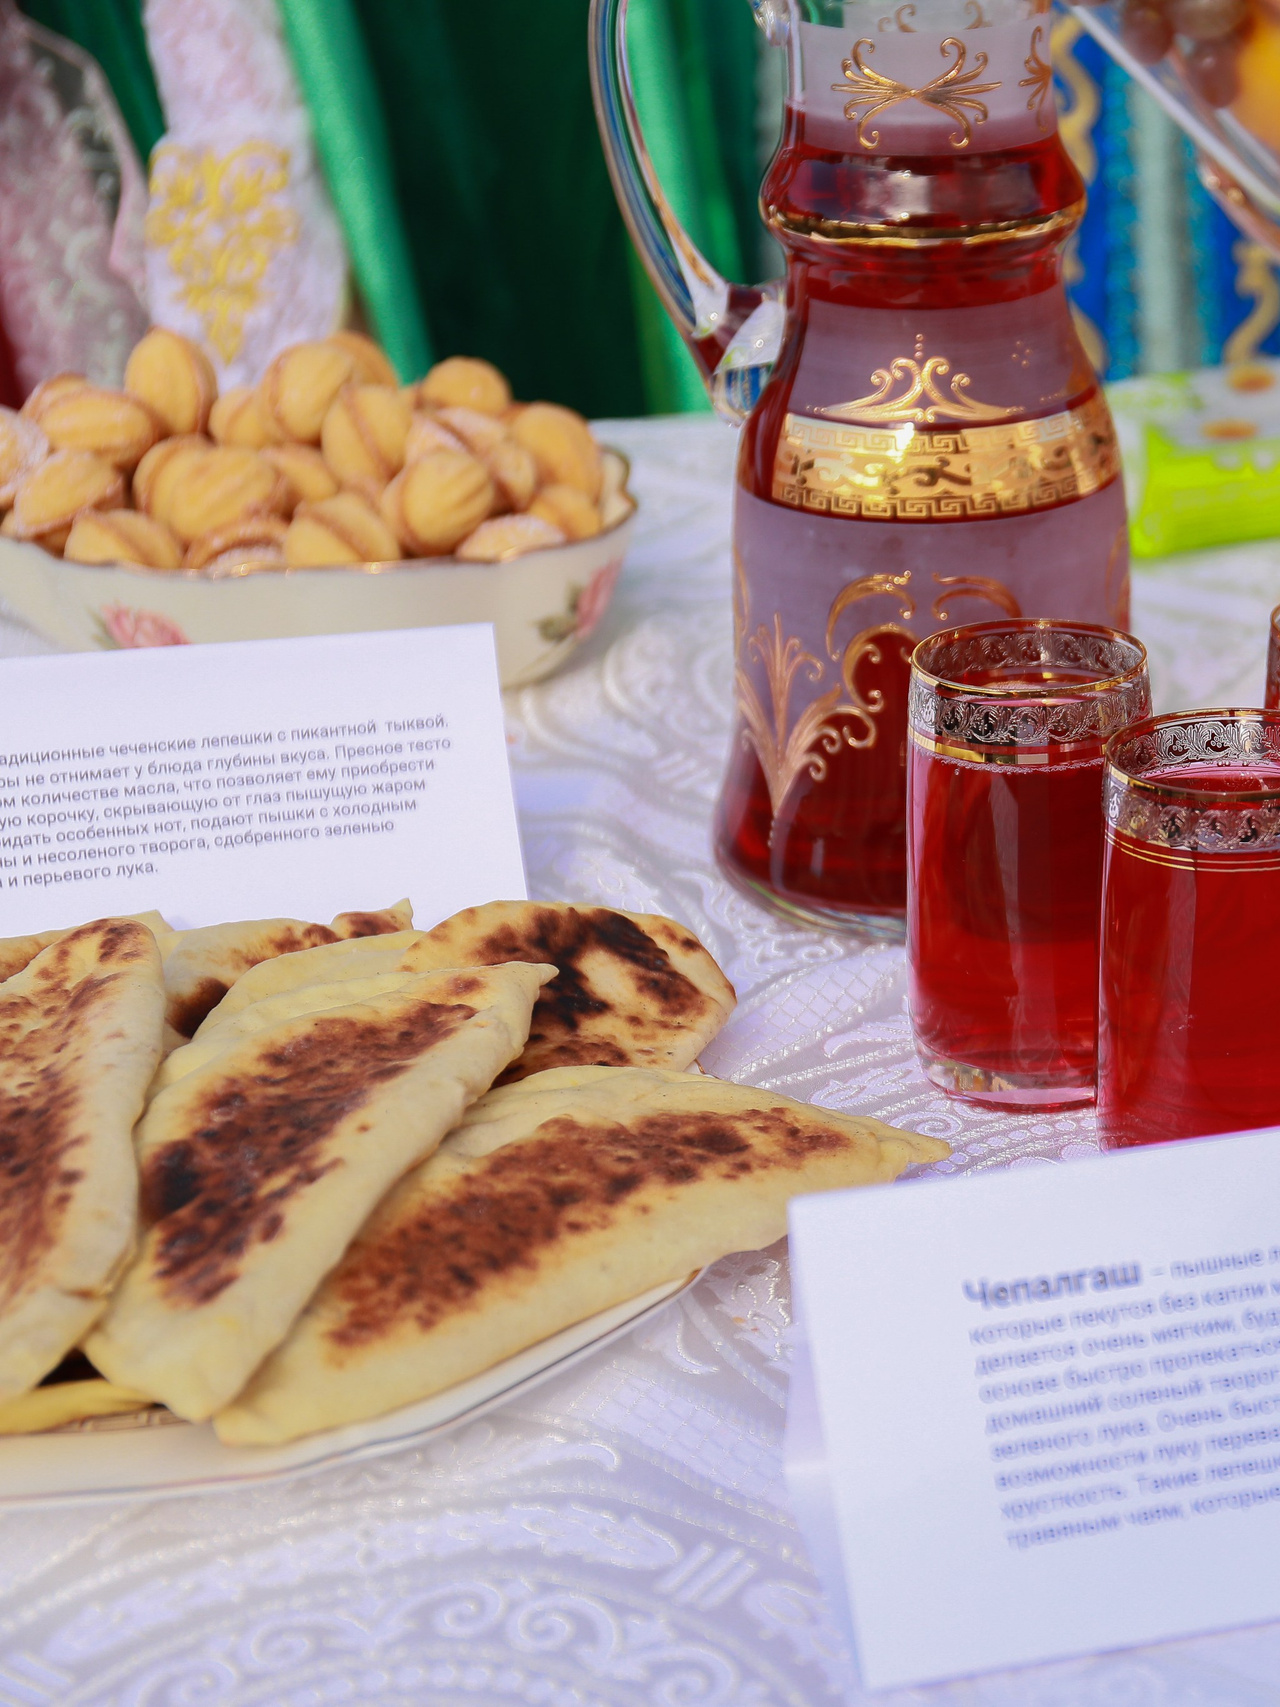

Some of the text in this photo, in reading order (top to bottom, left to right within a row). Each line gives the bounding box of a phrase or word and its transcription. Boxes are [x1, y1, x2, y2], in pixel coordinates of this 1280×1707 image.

[109, 738, 196, 756] чеченские
[201, 732, 273, 749] лепешки
[277, 730, 287, 742] с
[290, 719, 377, 741] пикантной
[385, 713, 449, 732] тыквой.
[0, 759, 435, 809] м количестве масла, что позволяет ему приобрести
[25, 773, 45, 787] не
[49, 766, 130, 784] отнимает
[133, 765, 143, 780] у
[147, 760, 203, 776] блюда
[207, 753, 276, 772] глубины
[280, 749, 330, 765] вкуса.
[334, 743, 403, 761] Пресное
[407, 738, 451, 752] тесто
[26, 809, 99, 827] корочку,
[103, 798, 218, 820] скрывающую
[222, 795, 241, 808] от
[245, 792, 282, 806] глаз
[285, 784, 368, 802] пышущую
[371, 779, 426, 795] жаром
[55, 823, 149, 843] особенных
[153, 820, 187, 834] нот,
[190, 813, 254, 831] подают
[258, 808, 315, 824] пышки
[319, 807, 329, 818] с
[332, 799, 417, 817] холодным
[0, 820, 395, 869] ы и несоленого творога, сдобренного зеленью
[8, 875, 19, 888] и
[23, 866, 112, 887] перьевого
[116, 862, 159, 879] лука.
[962, 1262, 1143, 1309] Чепалгаш
